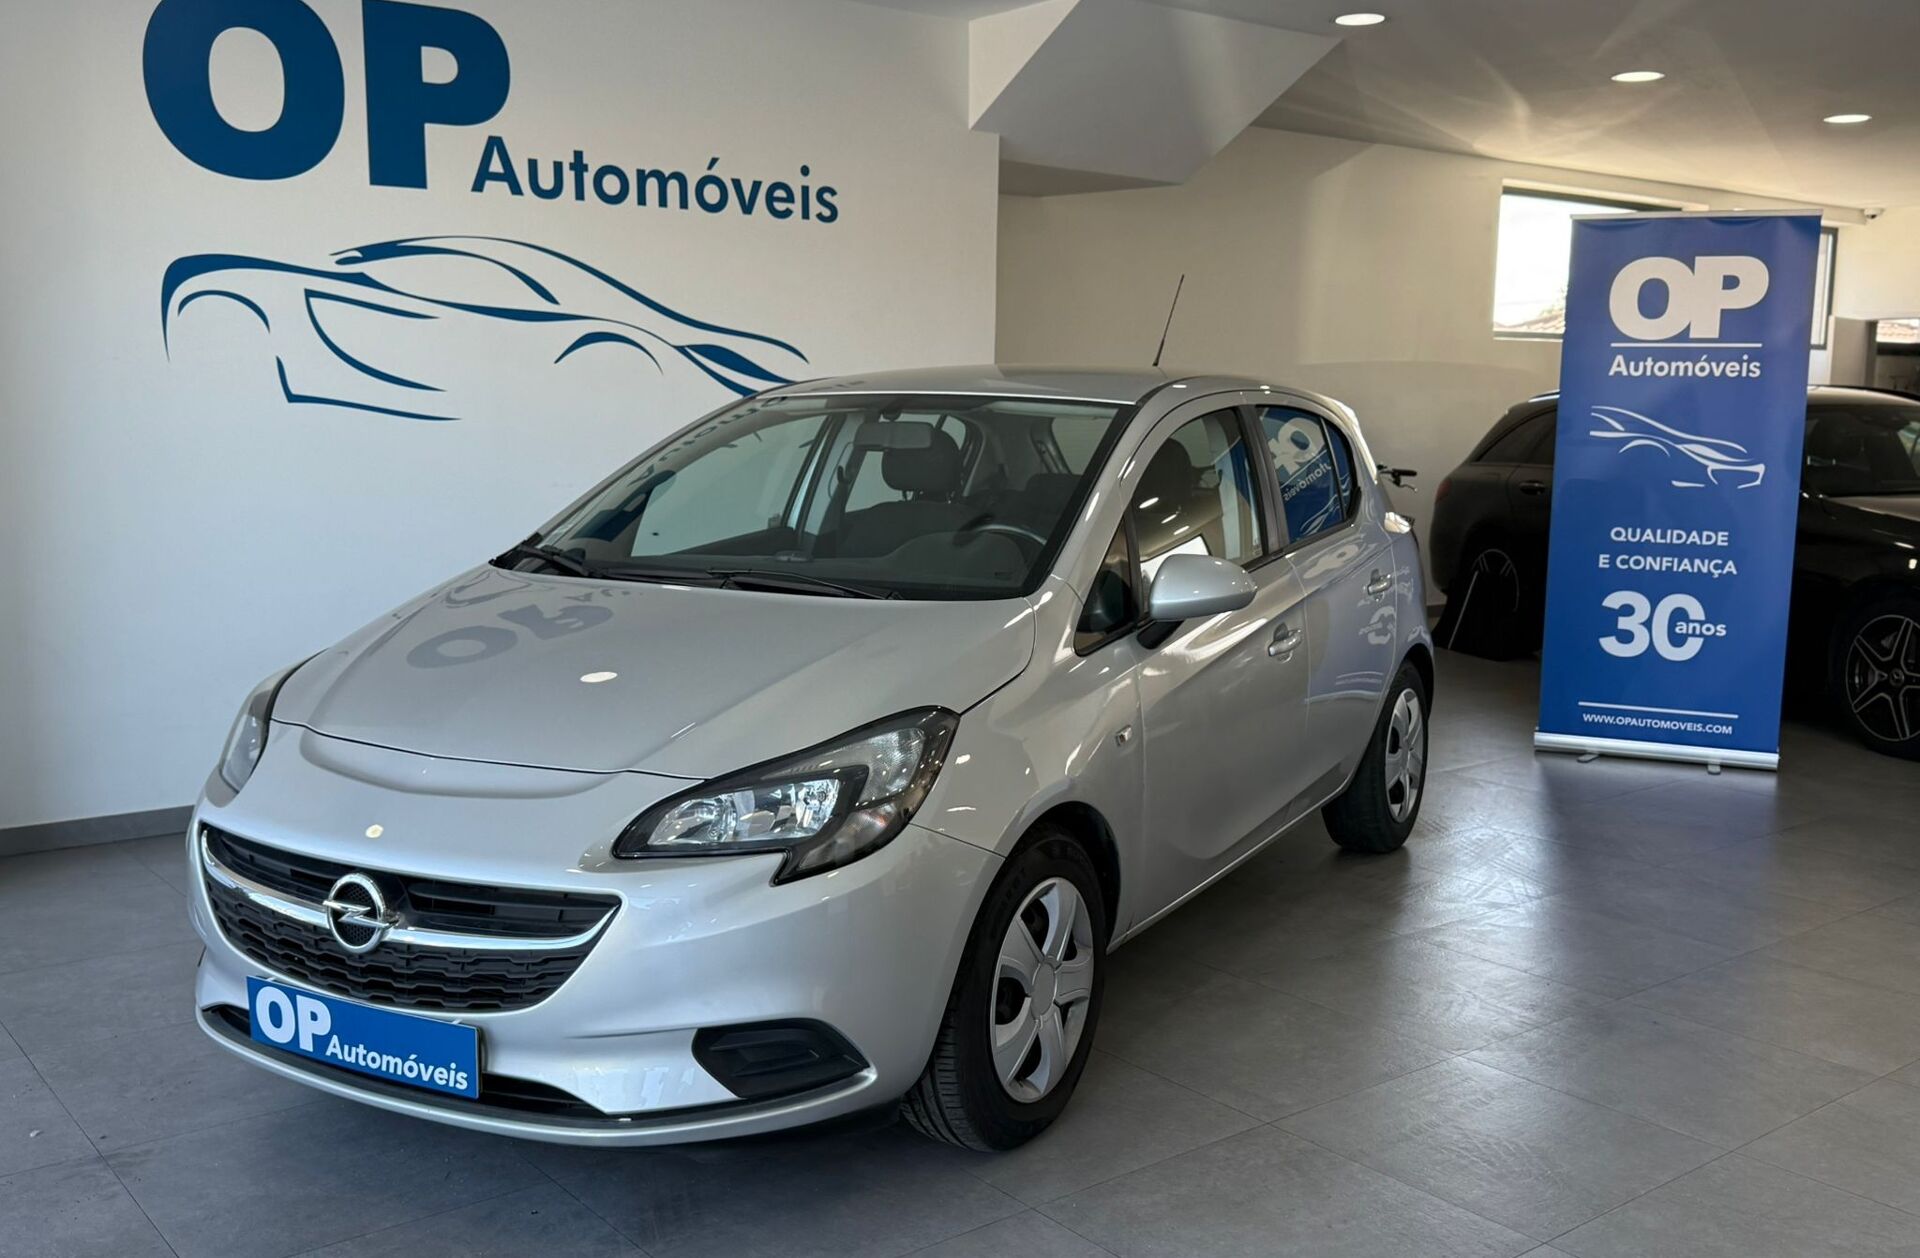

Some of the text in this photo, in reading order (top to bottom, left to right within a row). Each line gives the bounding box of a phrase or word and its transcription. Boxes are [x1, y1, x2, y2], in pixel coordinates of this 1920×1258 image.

[142, 0, 511, 189] OP
[470, 135, 840, 224] Automóveis
[1608, 255, 1770, 341] OP
[1608, 354, 1761, 378] Automóveis
[1598, 554, 1738, 579] E CONFIANÇA
[1610, 526, 1729, 546] QUALIDADE
[1598, 590, 1727, 662] 30 anos
[1582, 713, 1733, 735] WWW.OPAUTOMOVEIS.COM
[256, 986, 469, 1090] OP Automóveis
